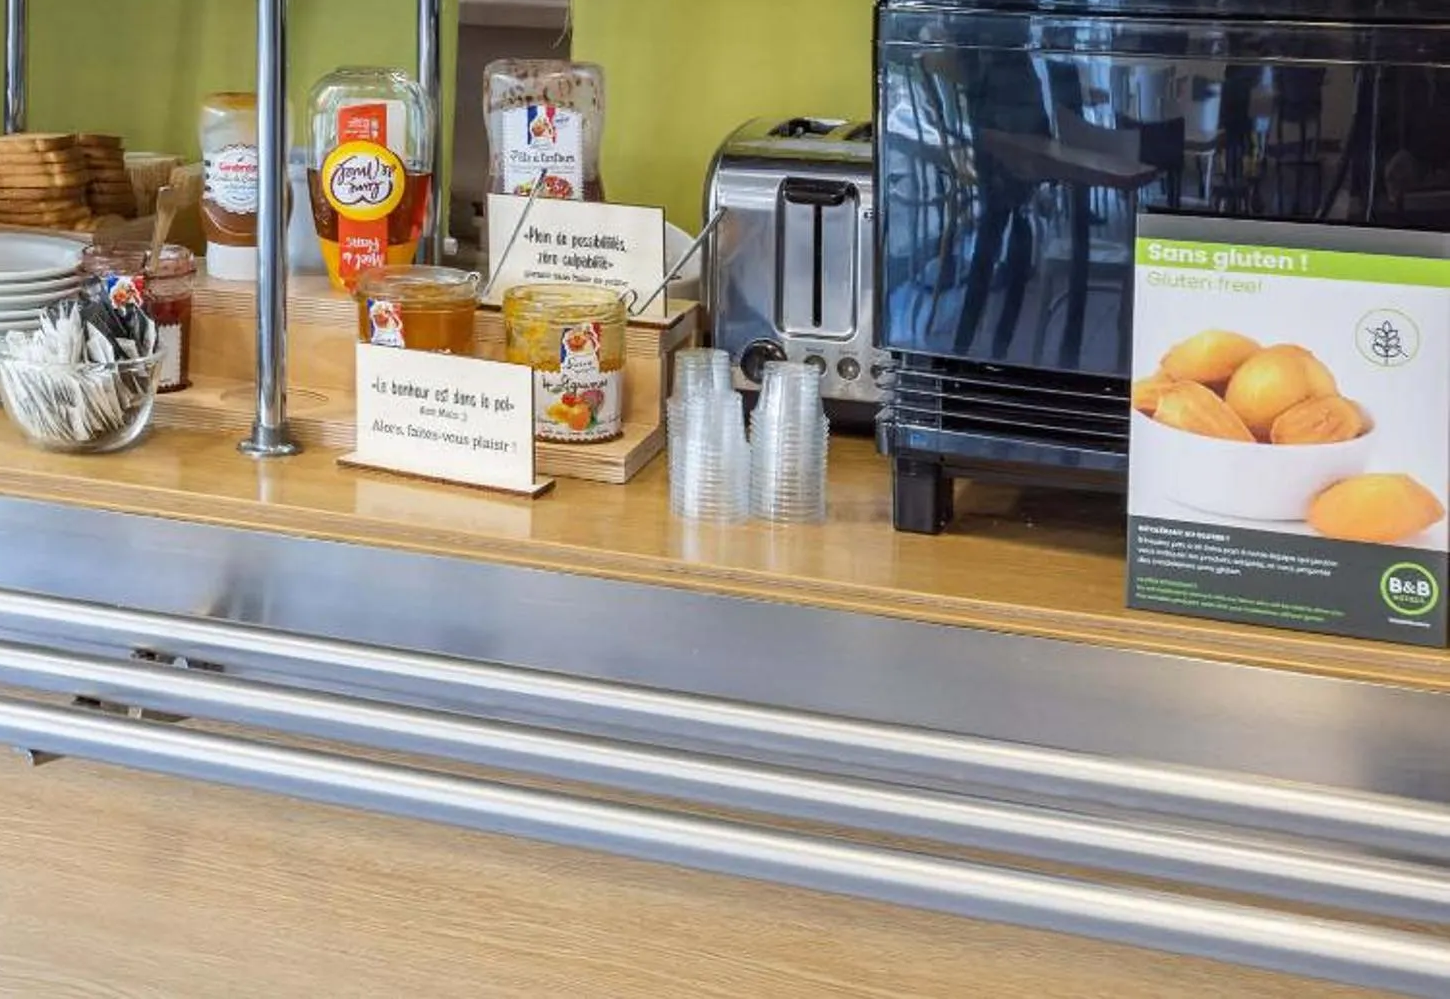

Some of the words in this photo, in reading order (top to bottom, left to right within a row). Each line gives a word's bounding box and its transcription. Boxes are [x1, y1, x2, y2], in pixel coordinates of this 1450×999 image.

[1147, 242, 1208, 264] Sans
[1212, 248, 1294, 272] gluten
[1301, 254, 1309, 272] !
[1147, 270, 1213, 291] Gluten
[1217, 276, 1264, 293] free!
[391, 380, 430, 400] bonheur
[434, 388, 449, 403] est
[453, 387, 477, 408] dans
[472, 435, 510, 453] plaisir
[1389, 576, 1431, 597] B&B
